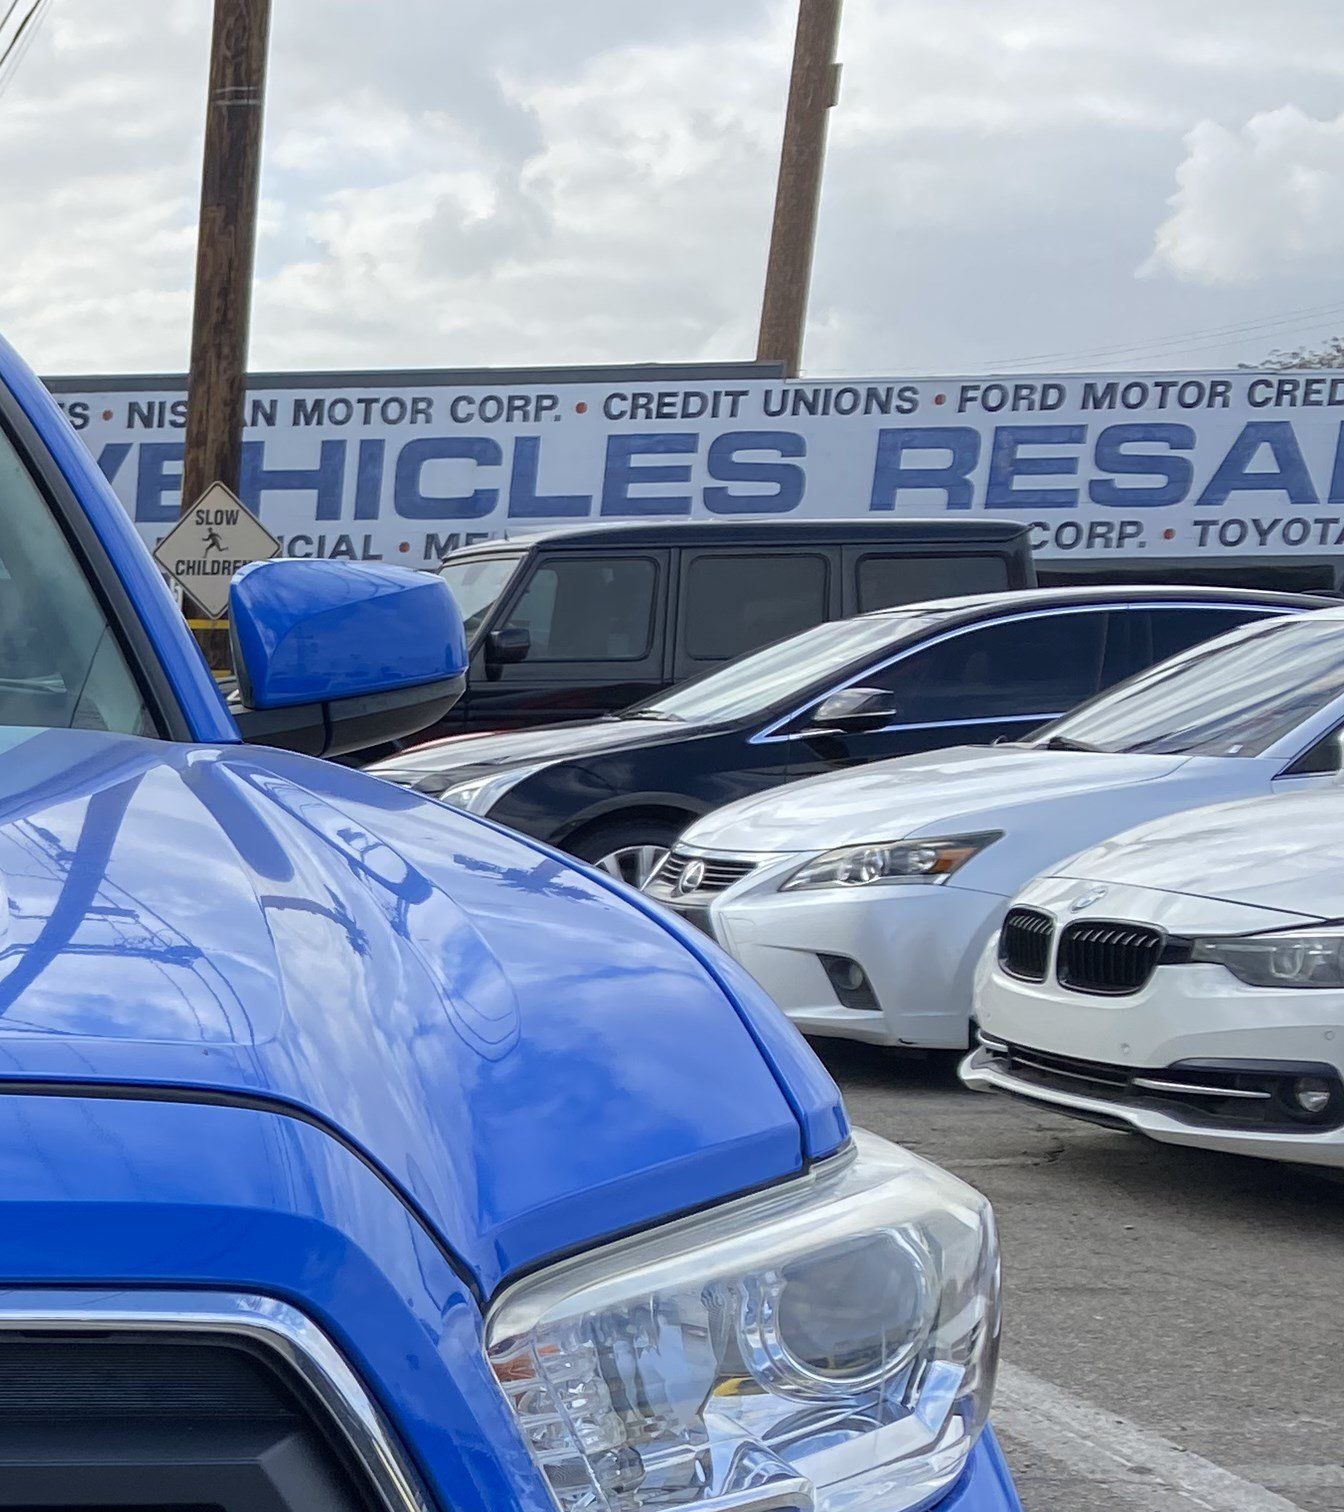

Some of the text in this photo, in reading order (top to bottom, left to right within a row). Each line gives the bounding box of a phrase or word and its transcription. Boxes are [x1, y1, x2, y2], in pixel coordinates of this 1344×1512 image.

[127, 398, 278, 429] NISN
[292, 397, 433, 427] MOTOR
[450, 393, 561, 423] CORP.
[604, 389, 749, 419] CREDIT
[763, 385, 919, 416] UNIONS
[957, 383, 1066, 412] FORD
[1081, 379, 1233, 410] MOTOR
[868, 421, 1344, 511] RESA
[195, 509, 239, 525] SLOW
[1031, 520, 1146, 550] CORP.
[175, 559, 254, 576] CHILDRE
